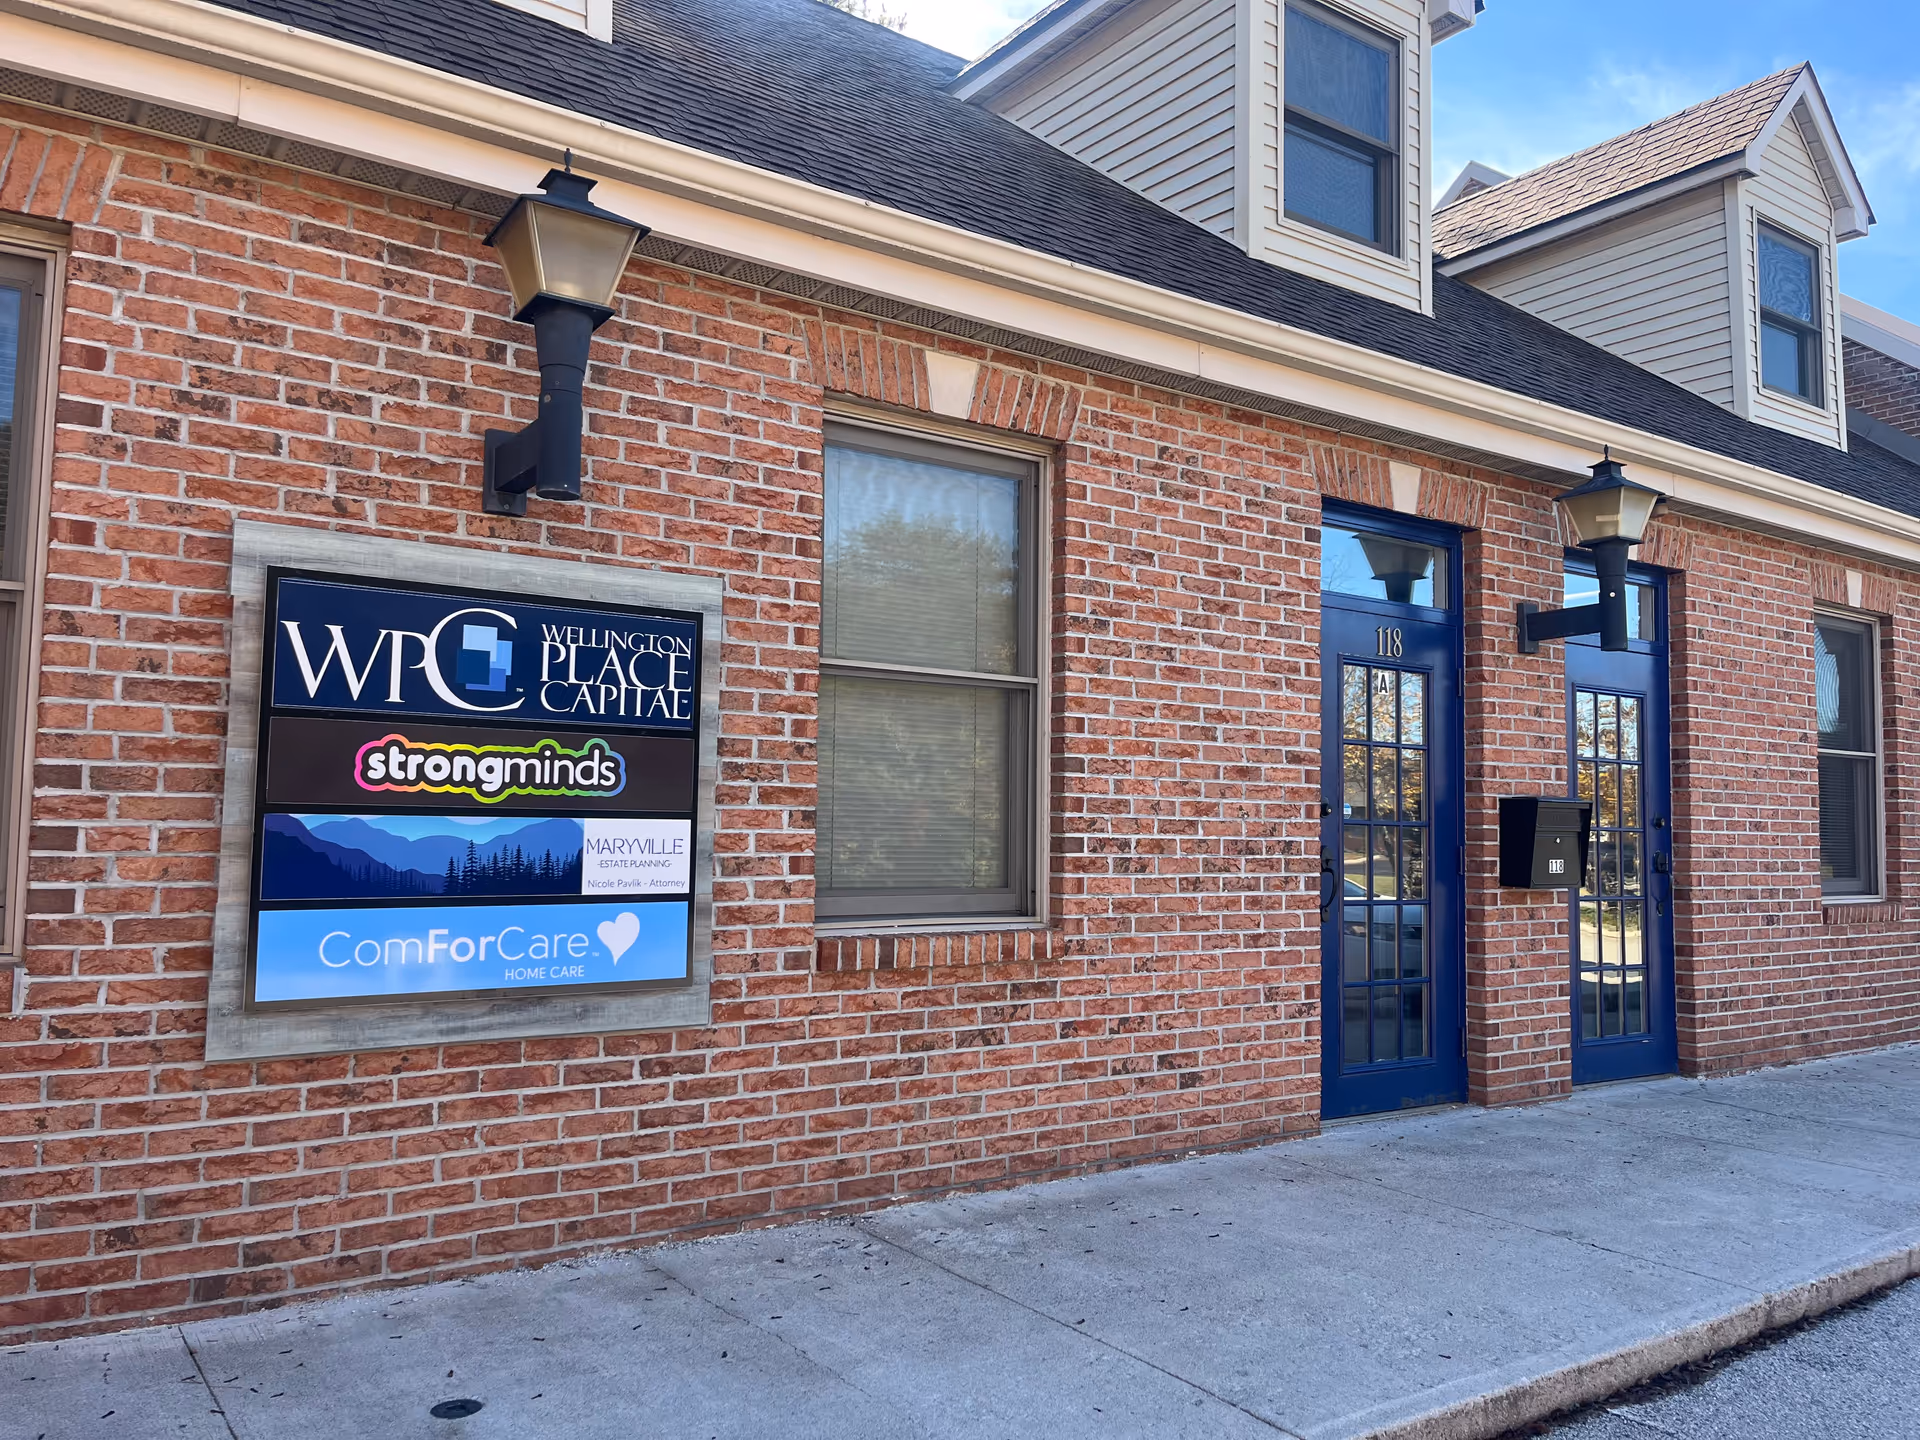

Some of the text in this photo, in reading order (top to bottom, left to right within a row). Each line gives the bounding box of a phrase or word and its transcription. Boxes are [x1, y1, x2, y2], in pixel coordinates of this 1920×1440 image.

[541, 624, 692, 660] WELLINGTON
[1376, 626, 1402, 657] 118
[280, 608, 525, 711] WPC
[540, 641, 692, 692] PLACE
[1379, 673, 1388, 693] A
[540, 681, 691, 720] CAPITAL
[367, 746, 616, 792] strongminds
[586, 838, 684, 855] MARYVILLE
[1550, 860, 1564, 873] 118
[587, 879, 615, 888] Nicole
[617, 879, 641, 888] Pavlik
[649, 879, 686, 888] Attorney
[319, 926, 589, 968] ComForCare
[505, 965, 585, 980] HOME CARE
